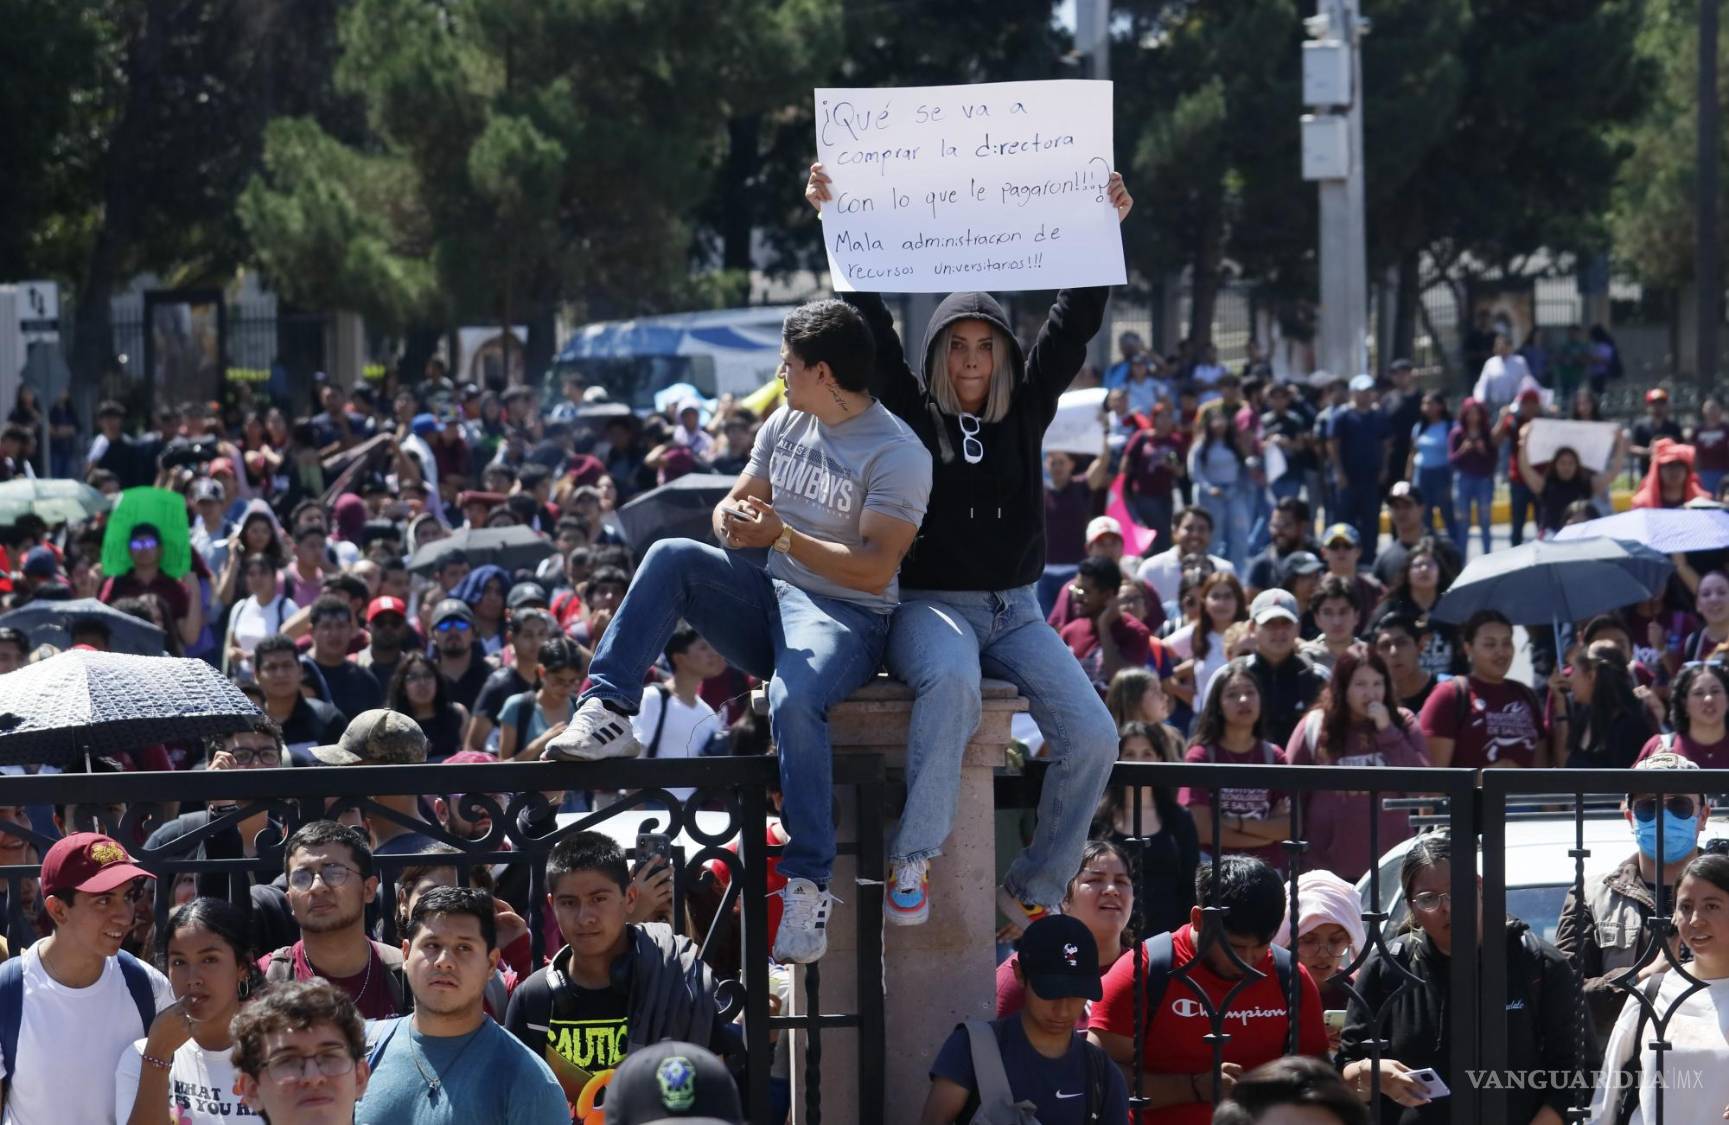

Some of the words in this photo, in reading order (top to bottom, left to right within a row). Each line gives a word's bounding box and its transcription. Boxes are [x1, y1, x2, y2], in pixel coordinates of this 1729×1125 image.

[916, 103, 945, 123] se
[962, 106, 990, 119] va
[1009, 101, 1028, 114] a
[837, 146, 921, 176] comprar
[941, 138, 959, 158] la
[975, 133, 1074, 158] directora
[892, 186, 910, 208] lo
[925, 189, 958, 219] que
[970, 177, 986, 201] le
[835, 230, 884, 253] Mala
[1033, 223, 1061, 241] de
[772, 451, 853, 512] OWBOYS
[1171, 998, 1287, 1026] Chmpion
[195, 1099, 231, 1115] YOU
